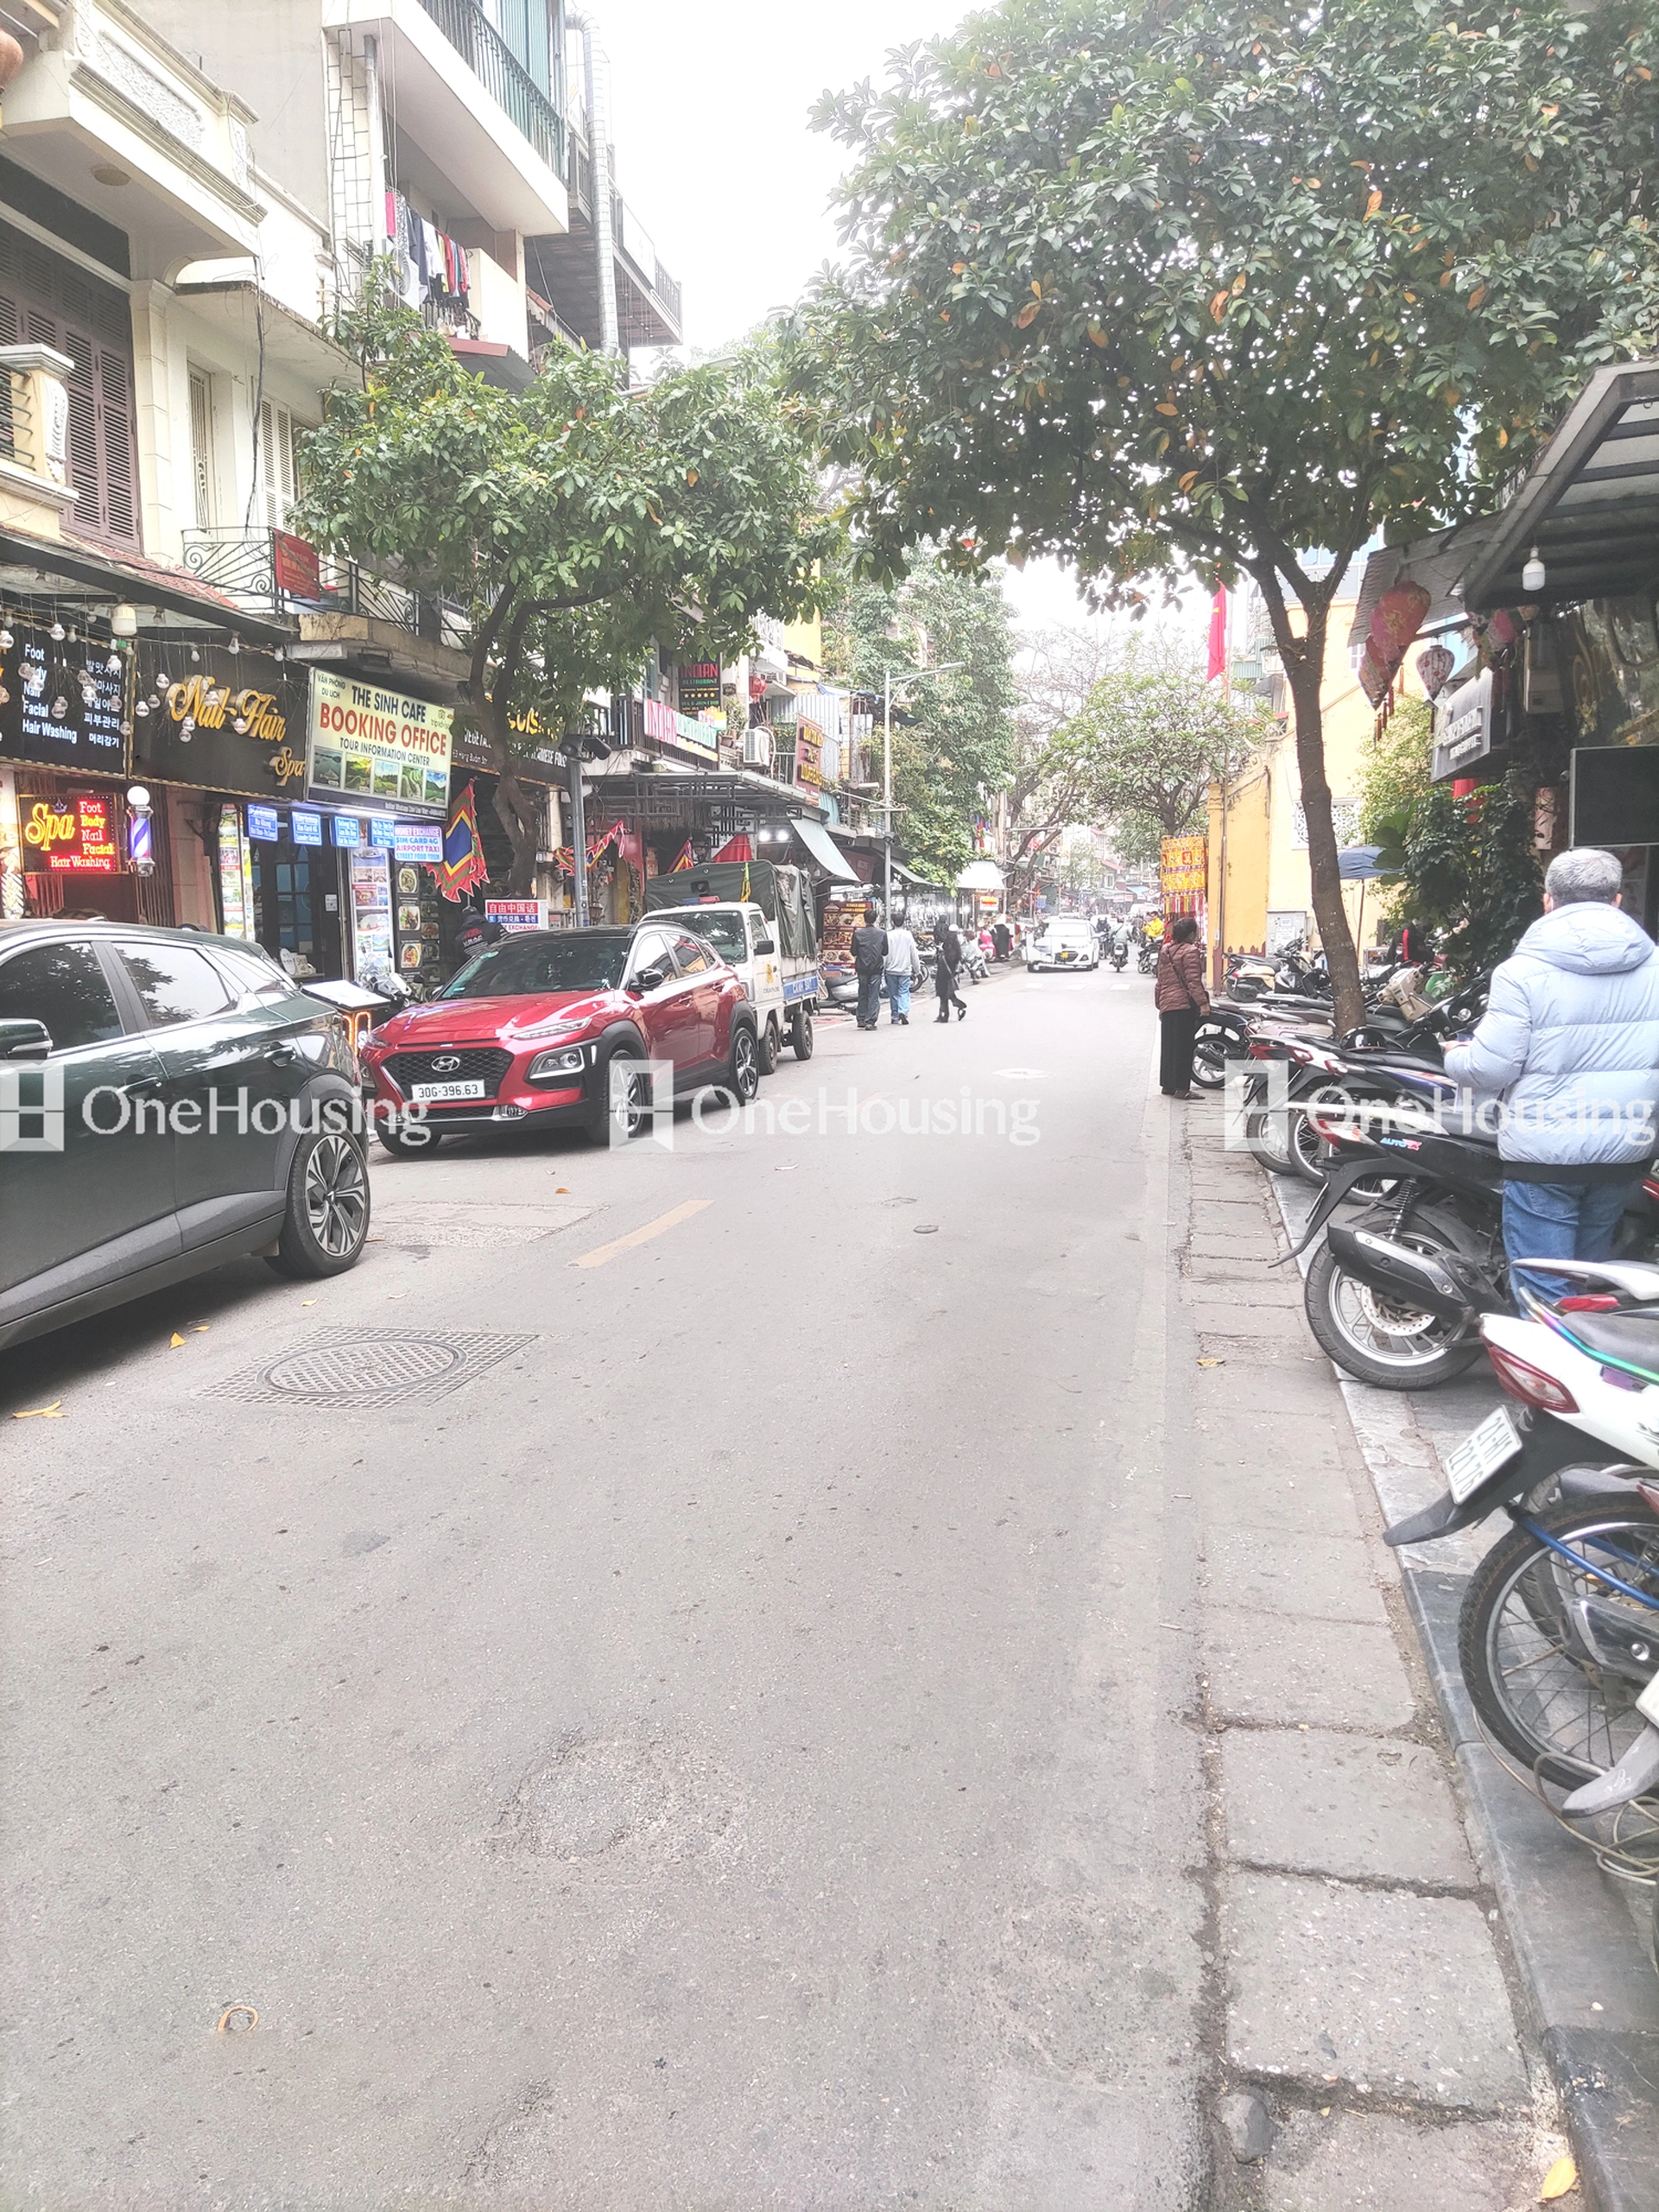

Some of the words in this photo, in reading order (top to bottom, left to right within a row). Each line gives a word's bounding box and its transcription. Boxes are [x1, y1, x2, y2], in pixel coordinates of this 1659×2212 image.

[25, 643, 45, 661] Foot
[23, 700, 48, 718] Facial
[351, 686, 370, 707] THE
[374, 693, 398, 715] SINH
[402, 700, 427, 723] CAFE
[84, 713, 120, 730] 피부관리
[320, 702, 396, 744] BOOKING
[401, 725, 446, 756] OFFICE
[22, 719, 41, 735] Hair
[41, 722, 77, 744] Washing
[339, 738, 359, 751] TOUR
[360, 743, 406, 761] INFORMATION
[408, 752, 430, 766] CENTER
[274, 747, 307, 786] Spa
[79, 802, 102, 813] Foot
[25, 803, 75, 851] Spa
[80, 814, 105, 828] Body
[81, 829, 103, 841] Nail
[82, 843, 115, 854] Facial
[50, 856, 71, 867] Hair
[70, 856, 111, 870] Washing
